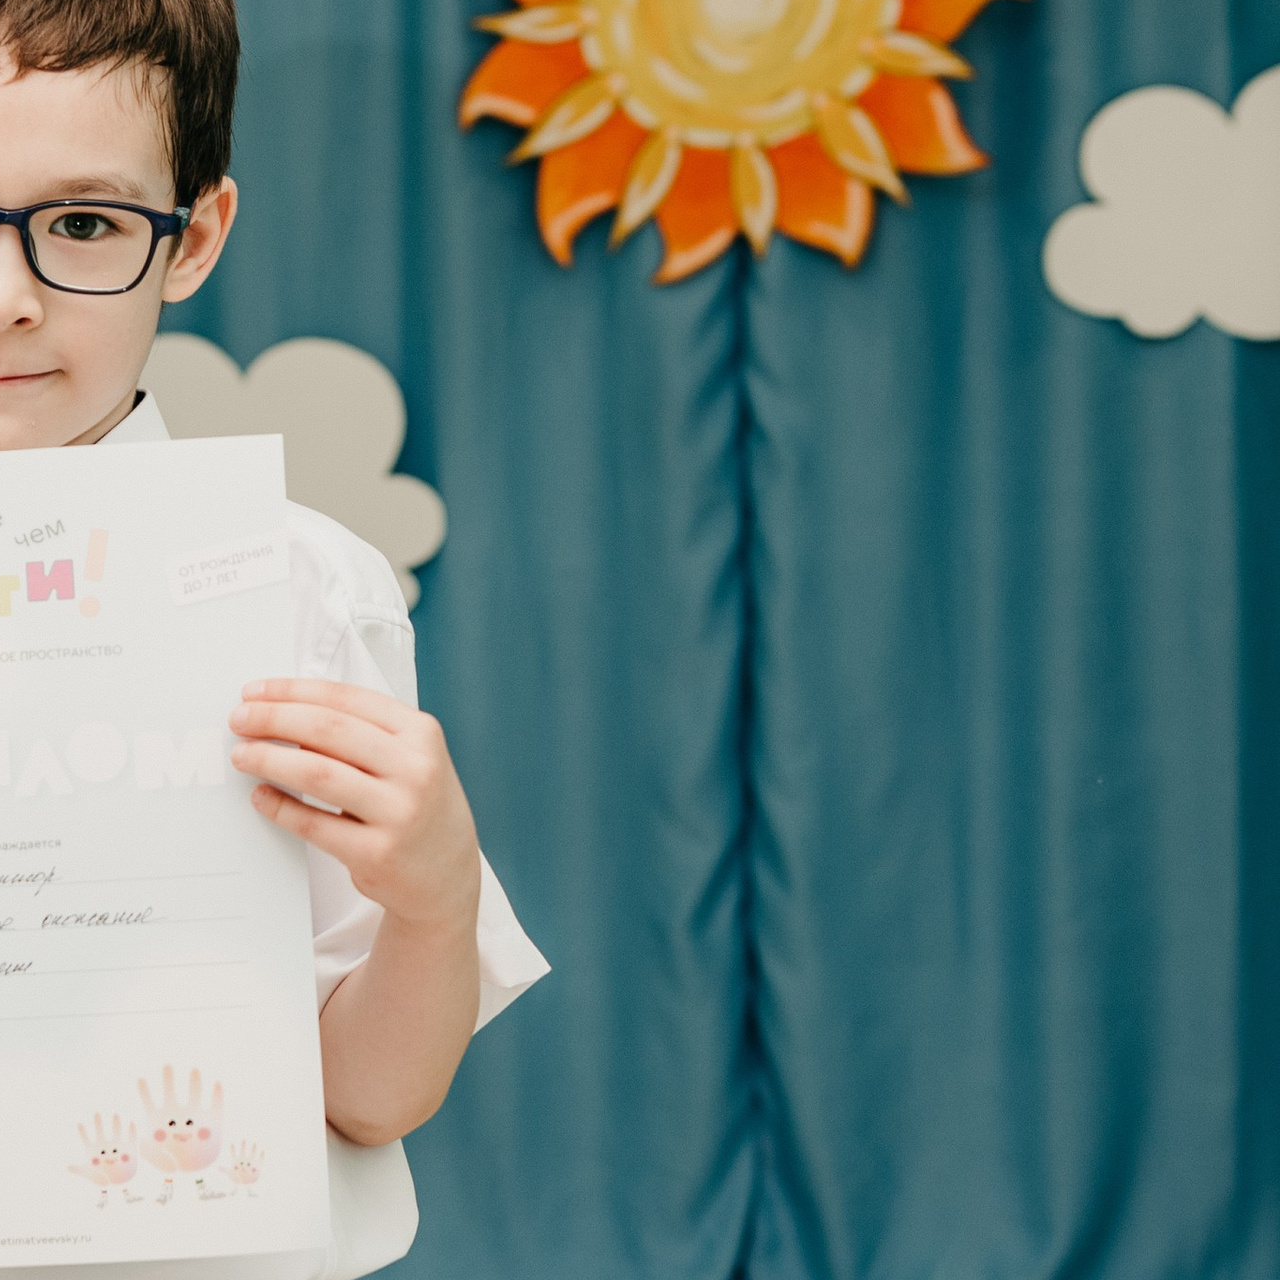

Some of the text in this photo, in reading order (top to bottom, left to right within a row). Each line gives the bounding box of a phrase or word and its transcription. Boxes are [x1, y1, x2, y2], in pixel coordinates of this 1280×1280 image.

[14, 519, 66, 548] чем
[178, 544, 274, 577] ОТ РОЖДЕНИЯ
[19, 644, 124, 662] ПРОСТРАНСТВО
